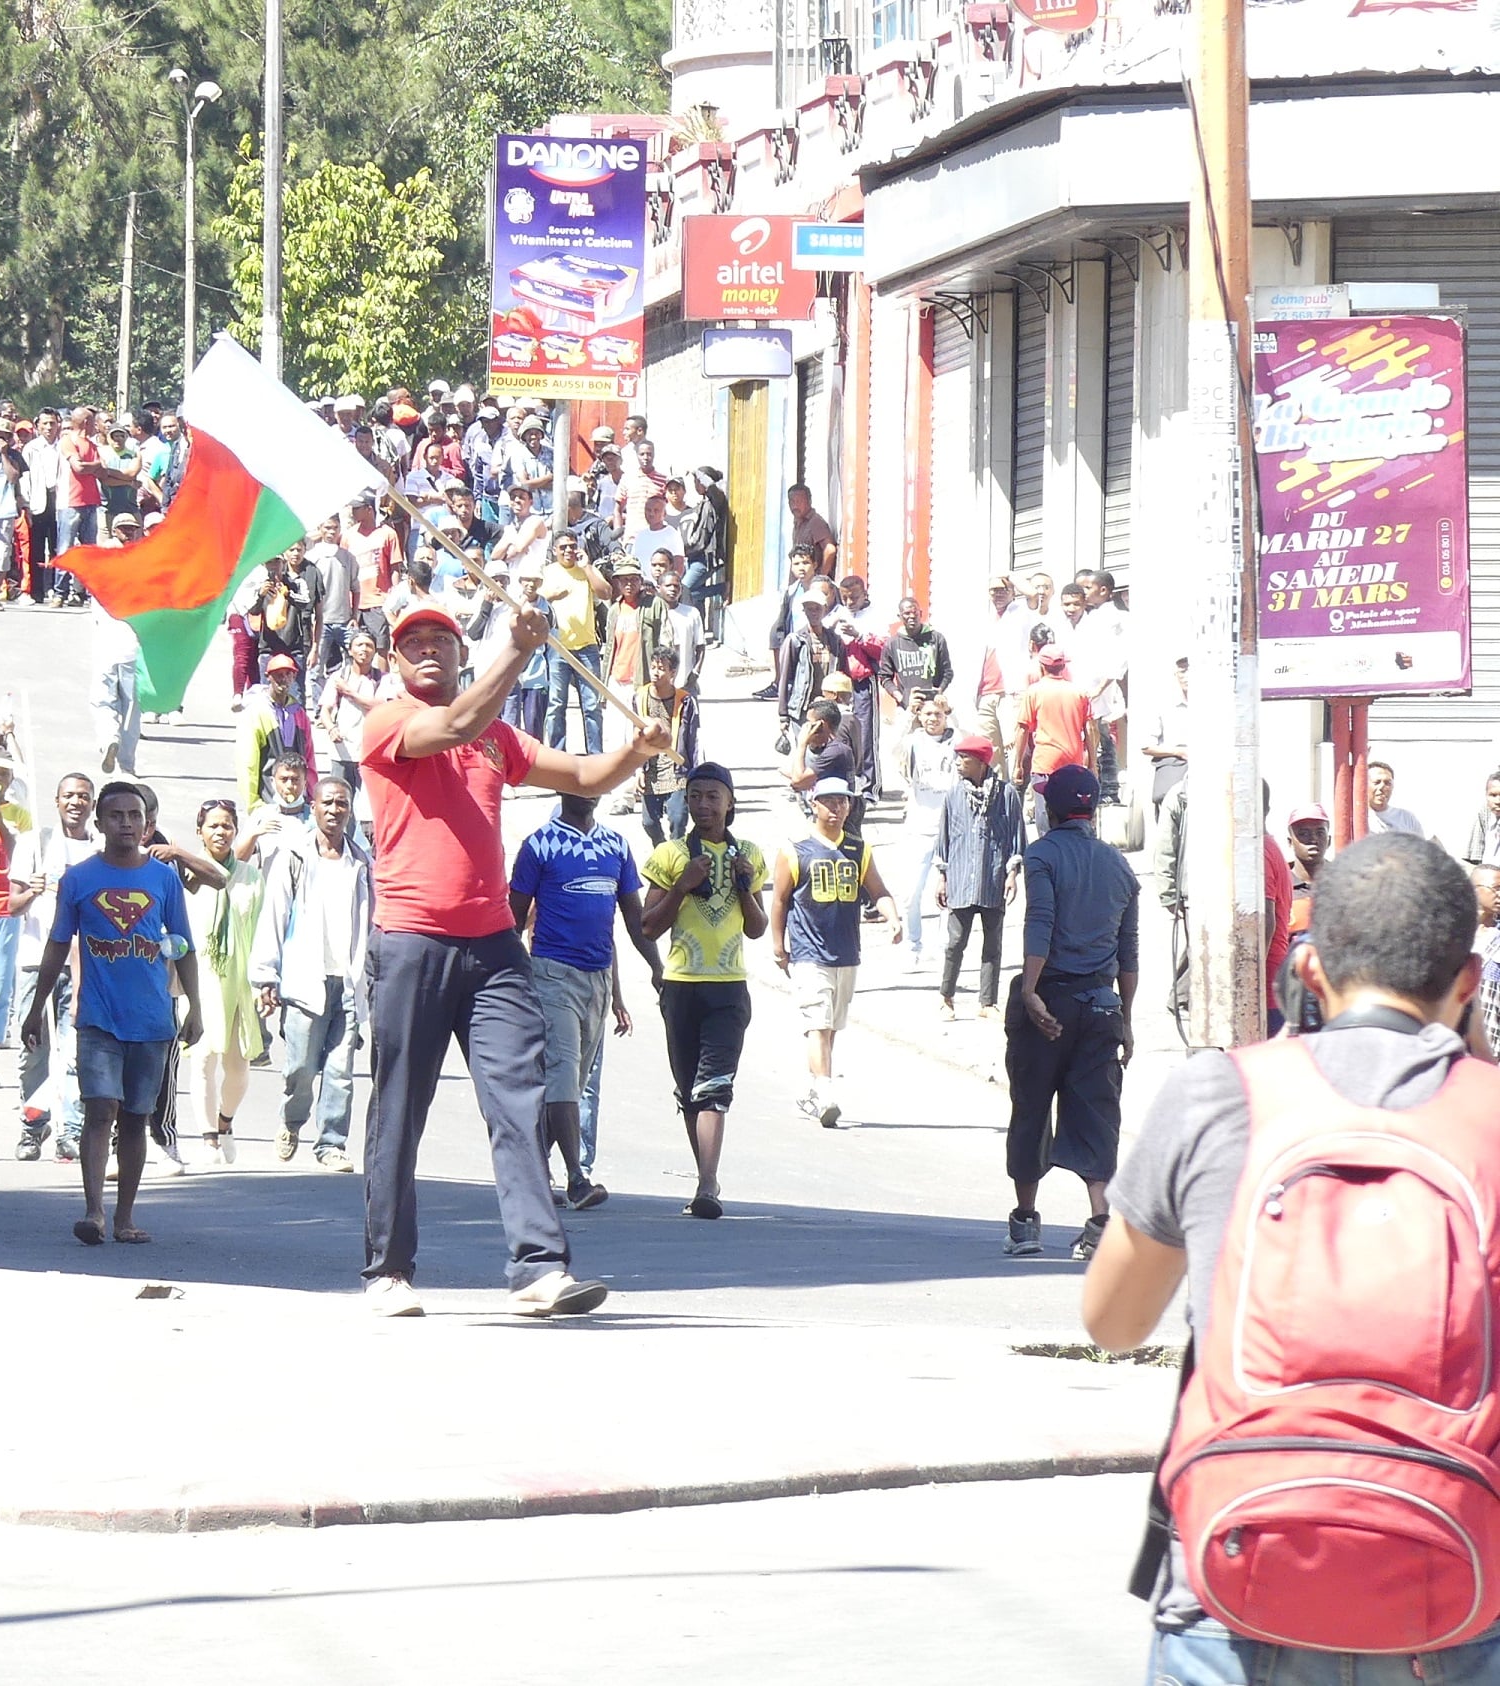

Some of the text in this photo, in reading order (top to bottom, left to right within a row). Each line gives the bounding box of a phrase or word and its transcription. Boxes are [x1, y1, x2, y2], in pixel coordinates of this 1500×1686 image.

[548, 226, 595, 235] Source de
[510, 234, 633, 249] Vitamines et Calcium
[809, 233, 863, 248] SAMSU
[716, 259, 785, 285] airtel
[721, 287, 780, 305] money
[1271, 294, 1329, 306] domapub
[490, 376, 612, 390] TOUJOURS AUSSI BON
[1309, 511, 1348, 529] DU
[1441, 522, 1449, 532] 10
[1261, 527, 1369, 555] MARDI
[1372, 524, 1413, 546] 27
[1314, 550, 1349, 568] AU
[1267, 562, 1400, 592] SAMEDI
[1268, 581, 1409, 612] 31 MARS
[810, 858, 859, 903] 08
